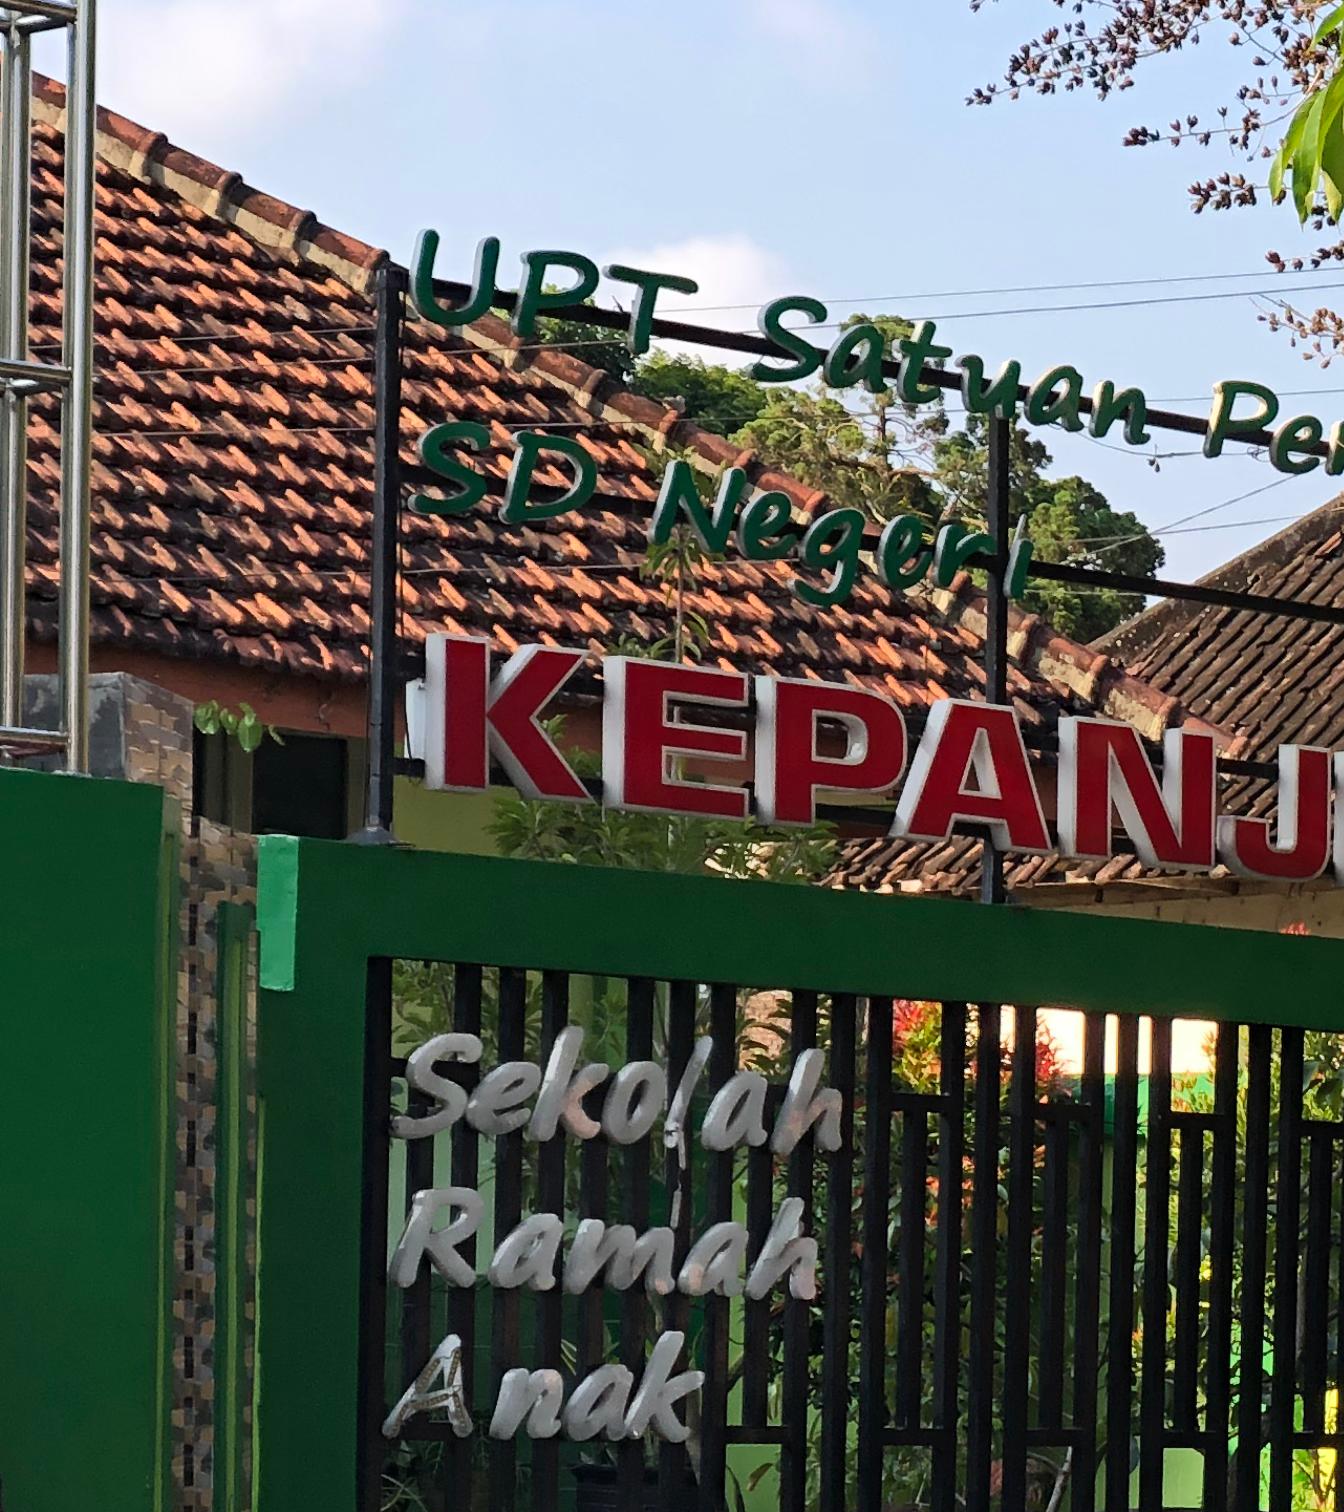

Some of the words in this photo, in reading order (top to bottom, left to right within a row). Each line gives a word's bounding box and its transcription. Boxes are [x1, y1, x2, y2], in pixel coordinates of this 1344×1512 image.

[409, 228, 698, 355] UPT
[749, 295, 1151, 446] Satuan
[407, 421, 599, 524] SD
[648, 458, 1034, 606] Negeri
[391, 1026, 842, 1157] Sekolah
[388, 1187, 818, 1300] Ramah
[382, 1331, 706, 1442] Anak
